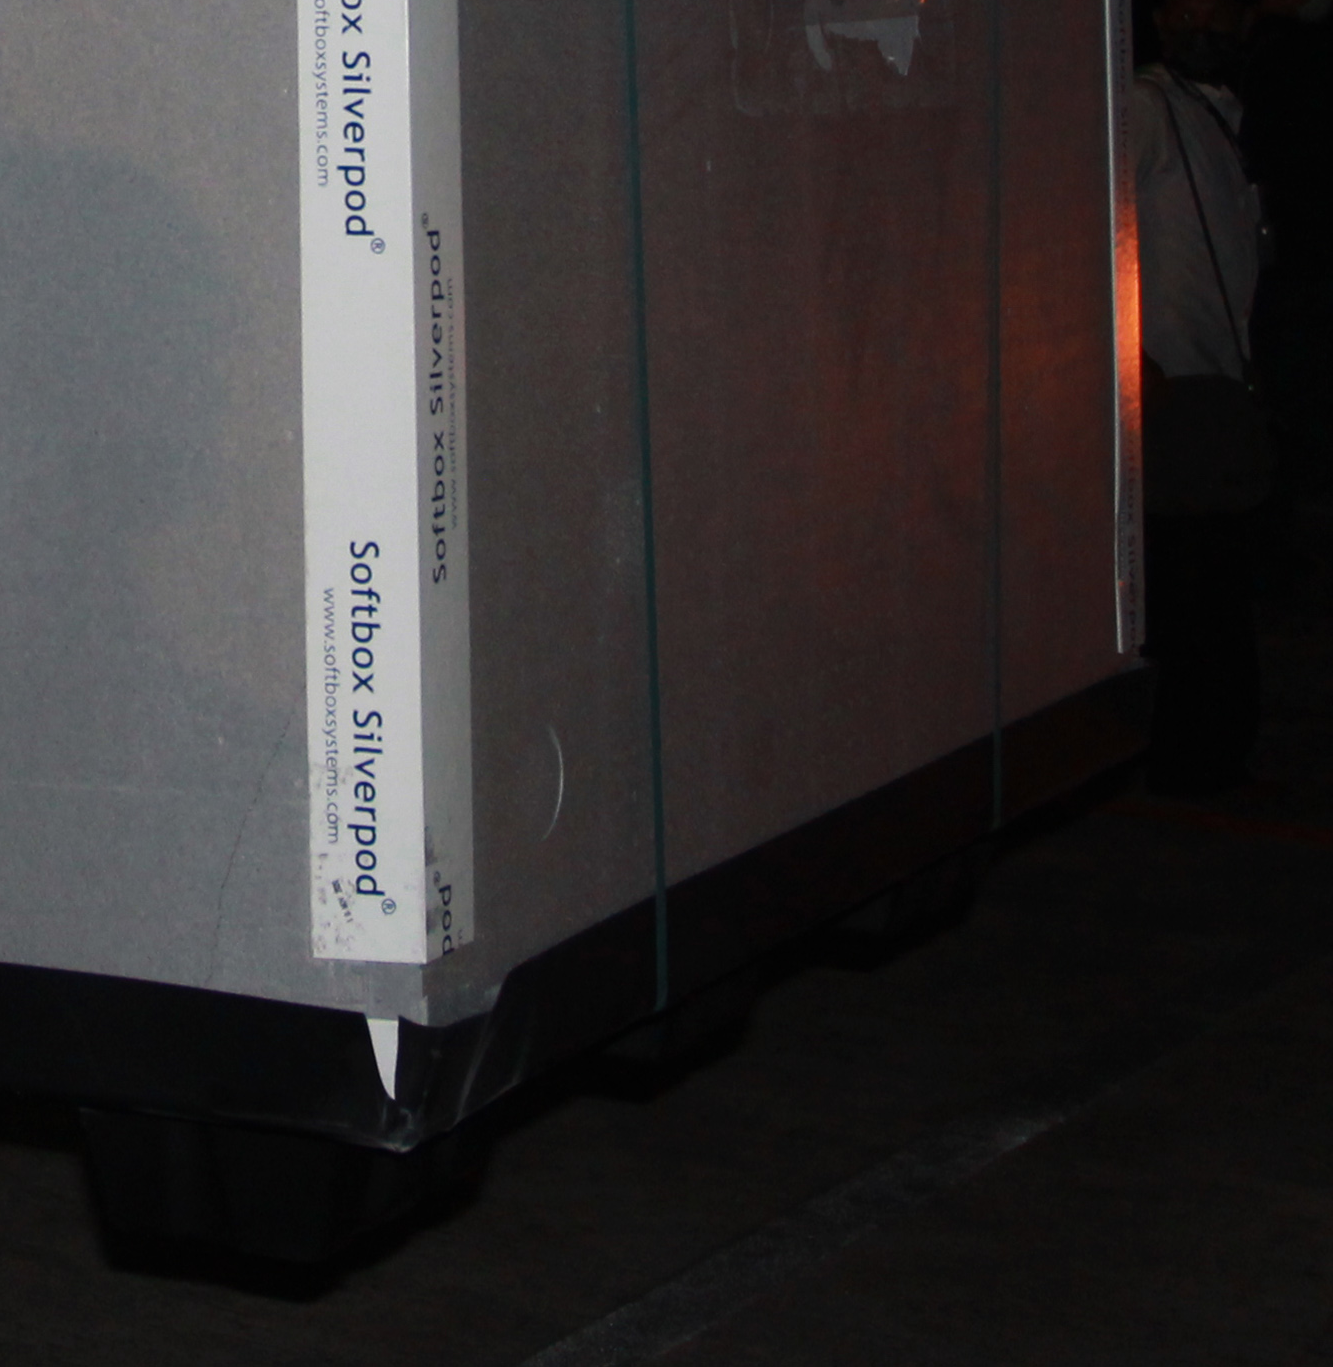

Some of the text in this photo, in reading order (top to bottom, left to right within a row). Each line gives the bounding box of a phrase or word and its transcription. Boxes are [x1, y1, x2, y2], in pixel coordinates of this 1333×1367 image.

[431, 431, 447, 584] Softbox
[350, 541, 381, 693] Softbox
[322, 587, 341, 844] www.softboxsystems.com
